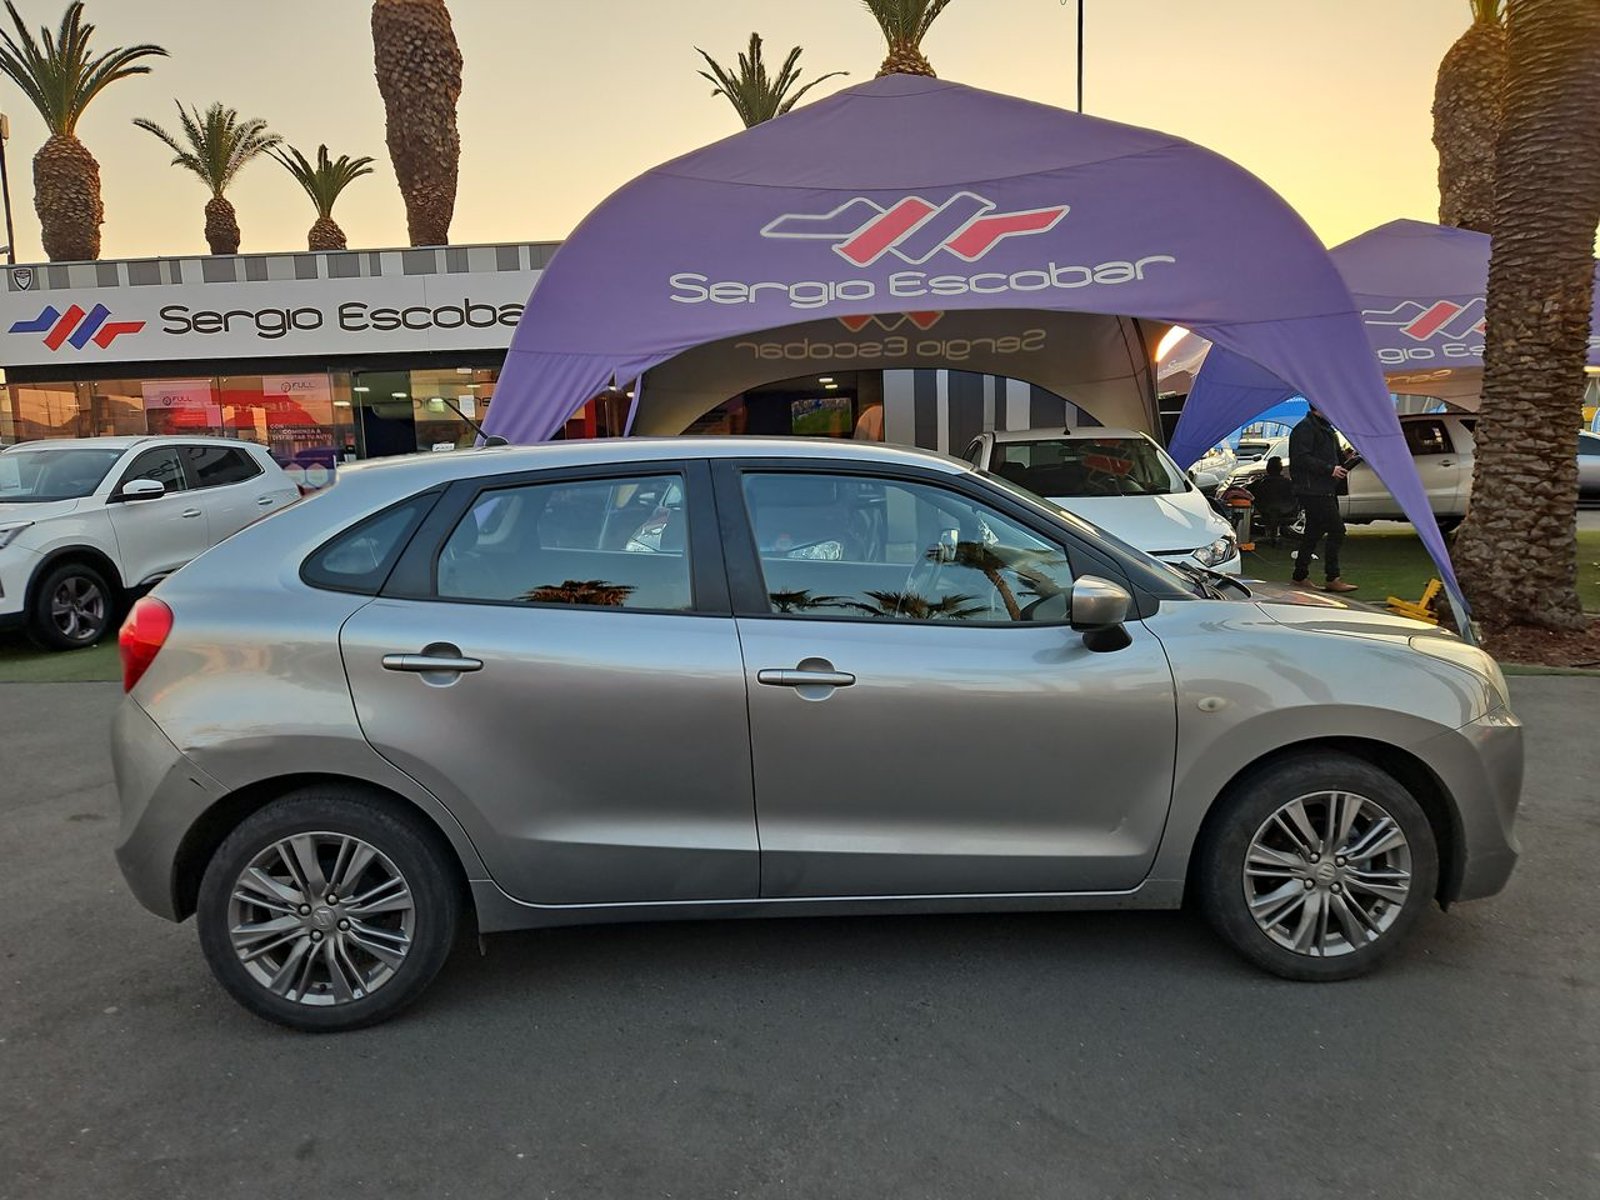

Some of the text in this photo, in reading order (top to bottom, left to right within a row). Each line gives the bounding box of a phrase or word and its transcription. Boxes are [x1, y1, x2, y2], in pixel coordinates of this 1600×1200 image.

[669, 254, 1176, 310] Sergio Escobar
[159, 304, 324, 339] Sergio
